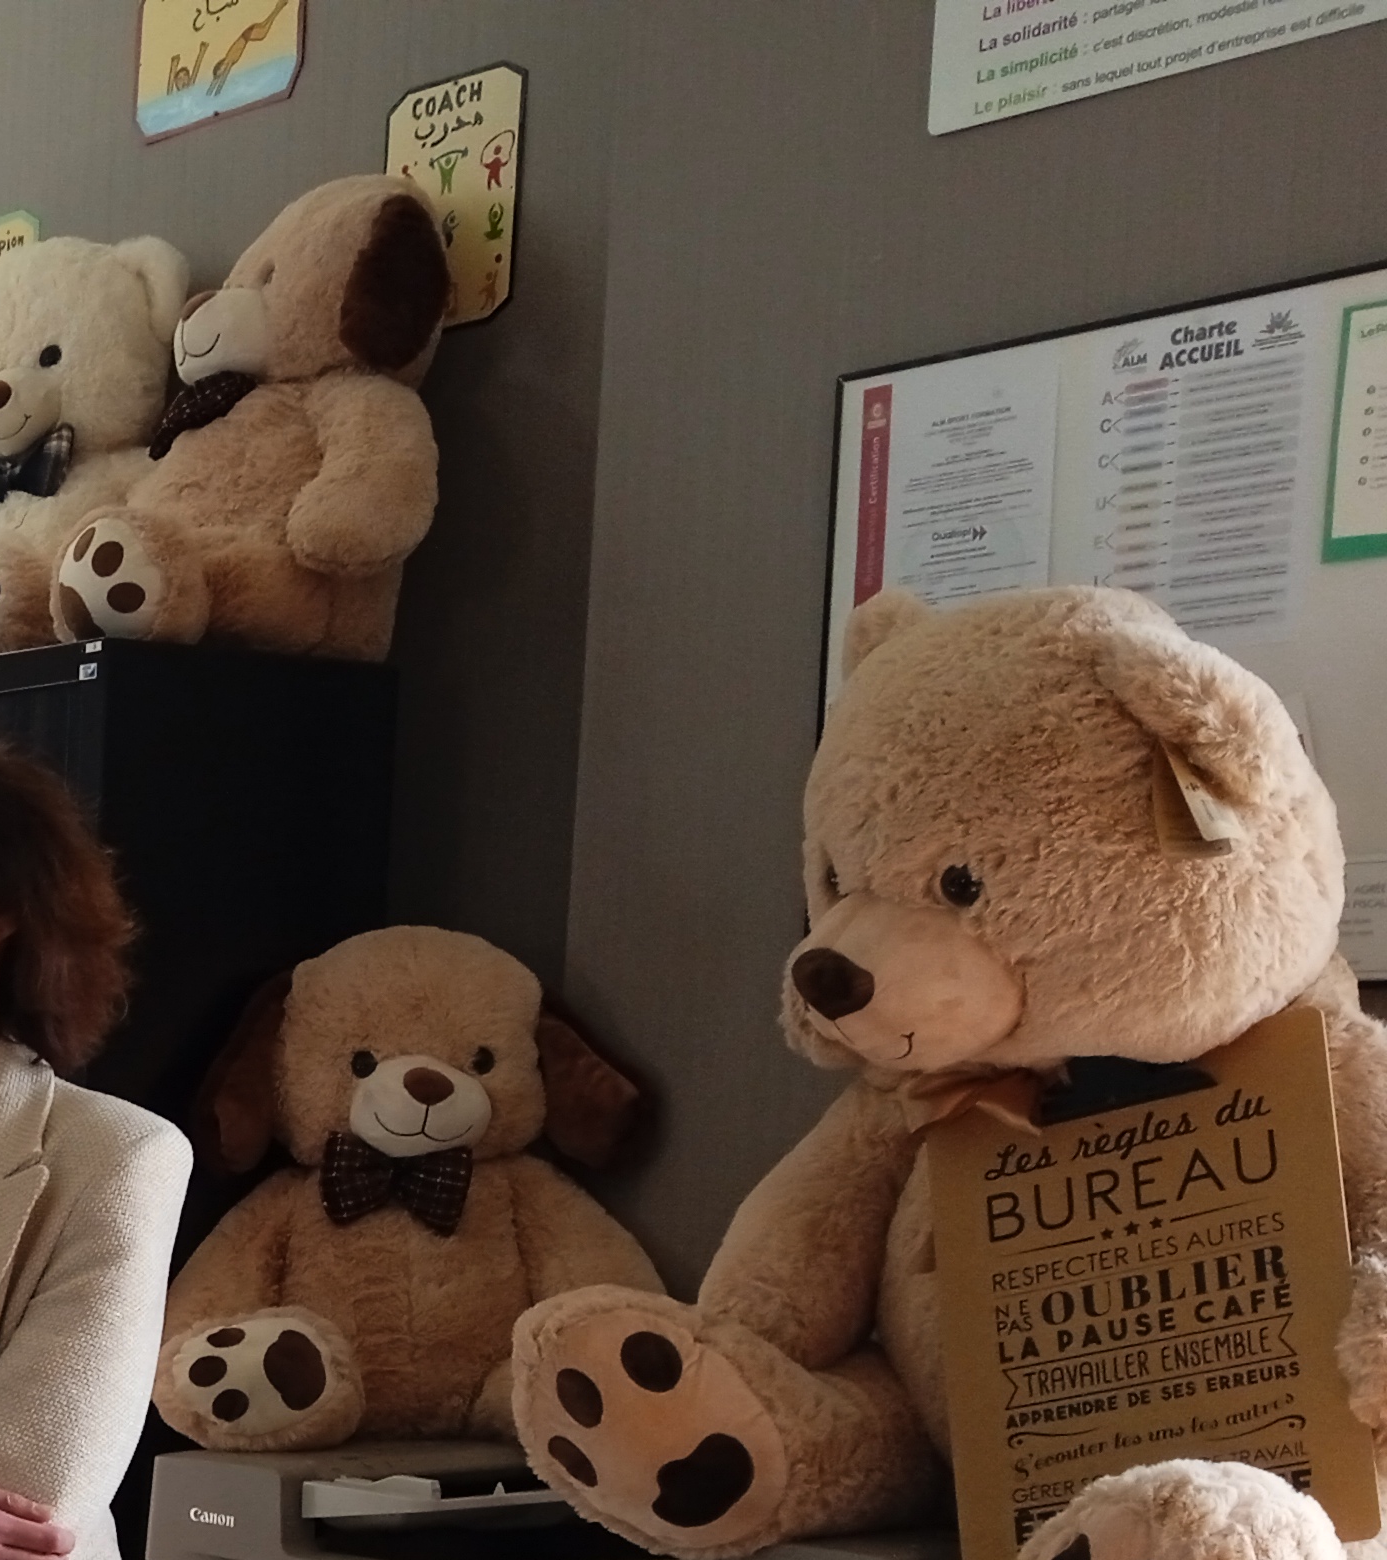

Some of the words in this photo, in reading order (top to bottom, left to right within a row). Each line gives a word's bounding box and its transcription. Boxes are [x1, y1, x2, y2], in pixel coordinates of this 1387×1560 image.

[1003, 12, 1078, 47] solidarité
[1001, 45, 1078, 79] simplicité
[412, 81, 483, 120] COACH
[1122, 353, 1147, 368] ALM
[1159, 339, 1244, 371] ACCUEIL
[1170, 320, 1237, 346] Charte
[984, 1143, 1058, 1181] Les
[1072, 1109, 1198, 1160] règles
[1215, 1088, 1271, 1123] du
[986, 1129, 1278, 1242] BUREAU
[992, 1247, 1128, 1293] RESPECTER
[1138, 1237, 1180, 1264] LES
[1186, 1212, 1285, 1250] AUTRES
[1041, 1244, 1289, 1325] OUBLIER
[996, 1316, 1033, 1336] PAS
[998, 1335, 1039, 1364] LA
[1058, 1307, 1176, 1353] PAUSE
[1194, 1281, 1293, 1323] CAFÉ
[1023, 1351, 1149, 1398] TRAVAILLER
[1161, 1326, 1272, 1373] ENSEMBLE
[1006, 1396, 1118, 1429] APPRENDRE
[1127, 1388, 1151, 1409] DE
[1161, 1379, 1197, 1402] SES
[1206, 1361, 1300, 1392] ERREURS
[1149, 1426, 1185, 1442] uns
[1226, 1392, 1295, 1425] autres
[189, 1506, 236, 1528] Canon
